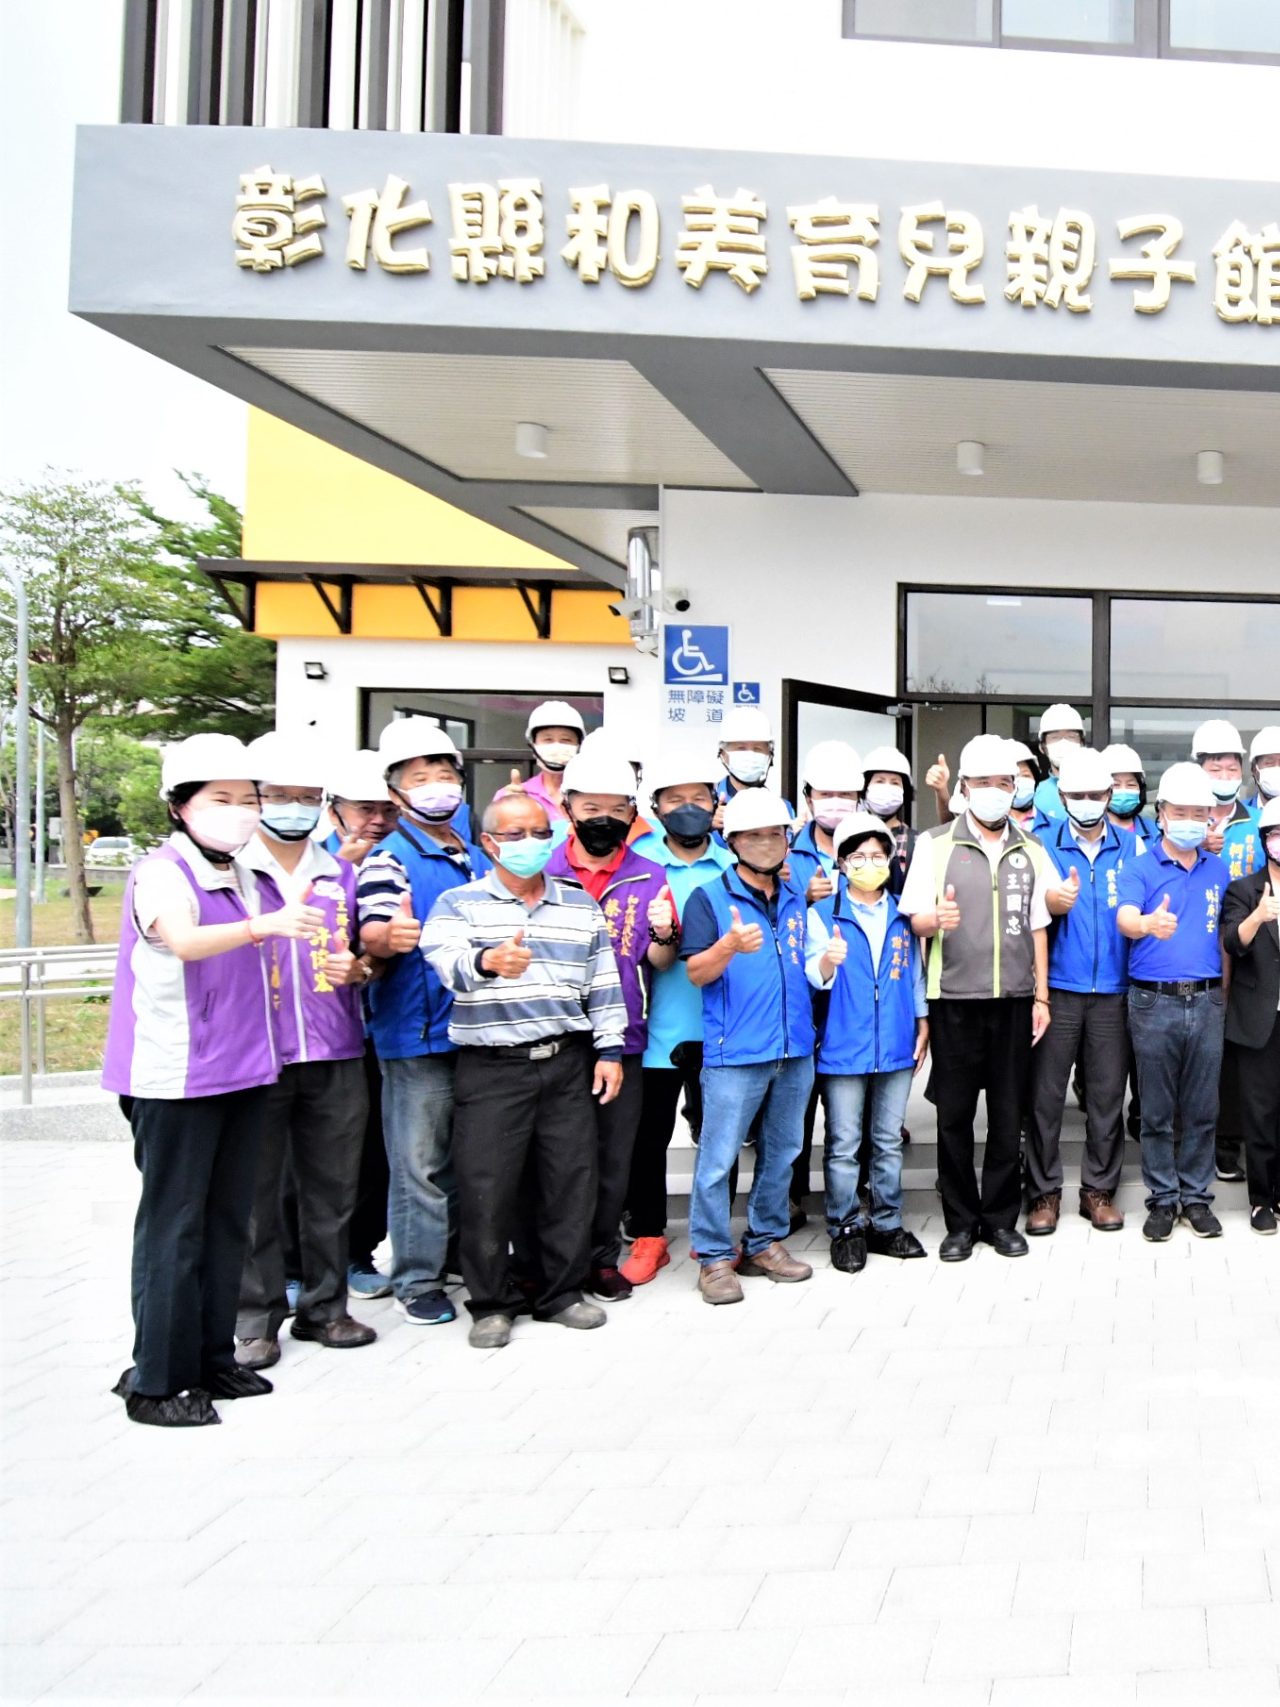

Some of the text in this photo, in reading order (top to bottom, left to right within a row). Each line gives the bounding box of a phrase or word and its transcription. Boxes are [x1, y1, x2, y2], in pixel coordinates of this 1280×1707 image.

[668, 690, 724, 704] 無障礙
[1006, 873, 1022, 935] 王國忠
